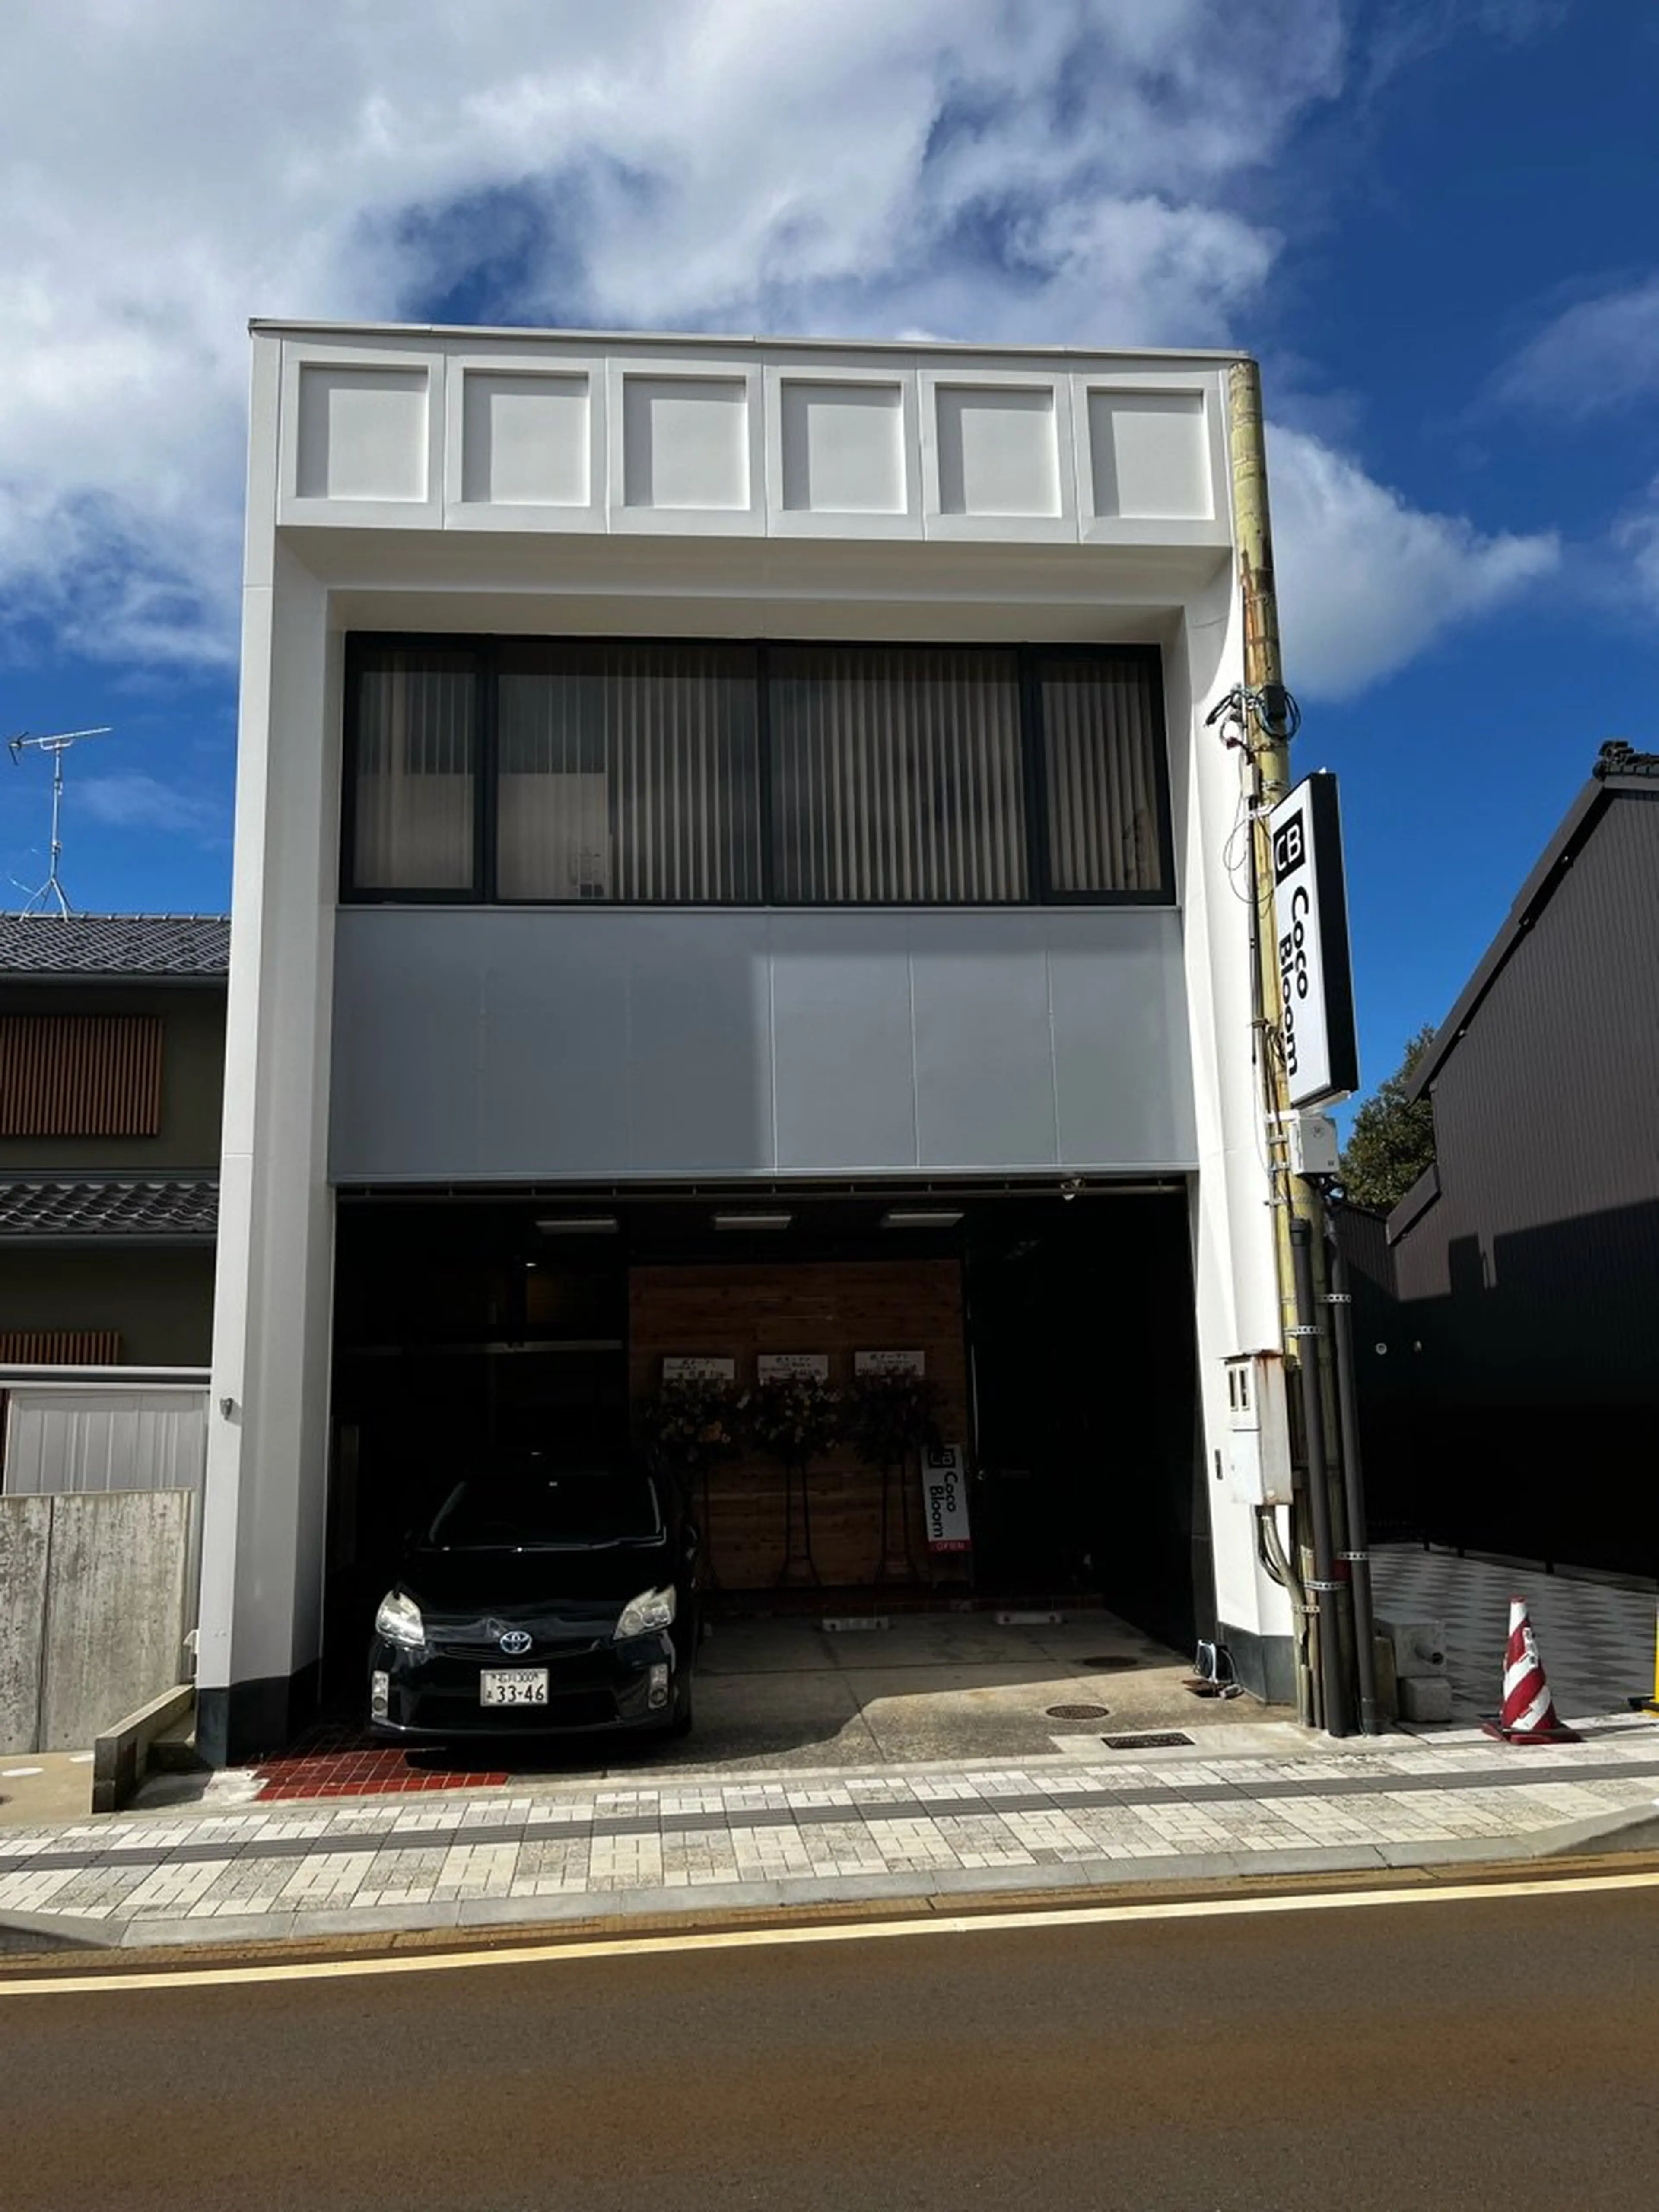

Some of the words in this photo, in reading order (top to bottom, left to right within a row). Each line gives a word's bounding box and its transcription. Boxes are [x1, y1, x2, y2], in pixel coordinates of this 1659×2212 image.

[1291, 885, 1309, 1000] Coco
[1279, 933, 1297, 1077] Bloom
[930, 1485, 944, 1538] Bloom
[944, 1471, 958, 1512] Coco
[496, 1684, 544, 1703] 33-46
